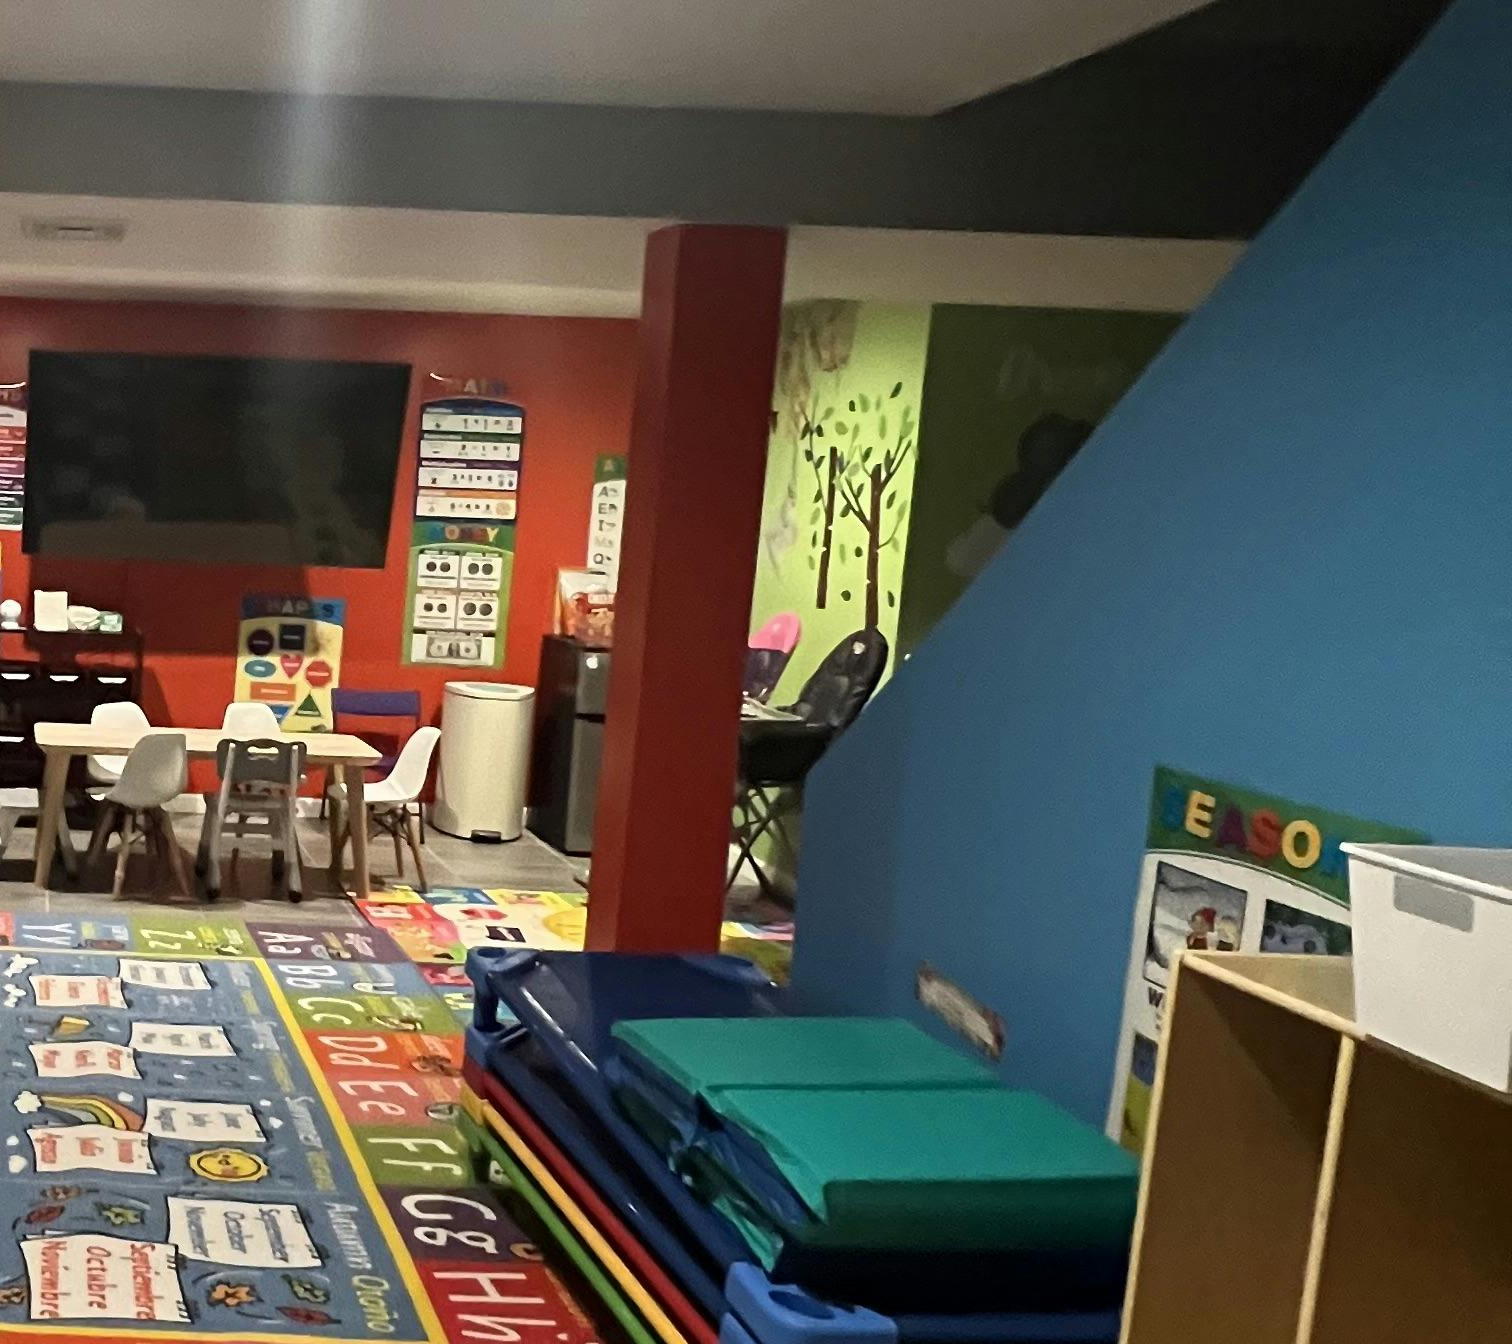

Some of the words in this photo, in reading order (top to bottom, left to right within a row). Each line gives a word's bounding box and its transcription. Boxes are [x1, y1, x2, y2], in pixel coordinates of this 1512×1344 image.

[279, 962, 340, 991] Bb
[318, 1034, 402, 1073] Dd
[336, 1079, 420, 1118] Ee
[366, 1136, 463, 1178] Ff
[182, 1205, 215, 1258] November
[222, 1211, 253, 1254] October
[253, 1207, 296, 1264] September
[37, 1241, 72, 1319] Noviembre
[85, 1246, 115, 1309] Octubre
[115, 1242, 159, 1320] Septiembre
[350, 1273, 399, 1334] Otoño
[433, 1270, 558, 1344] Hh
